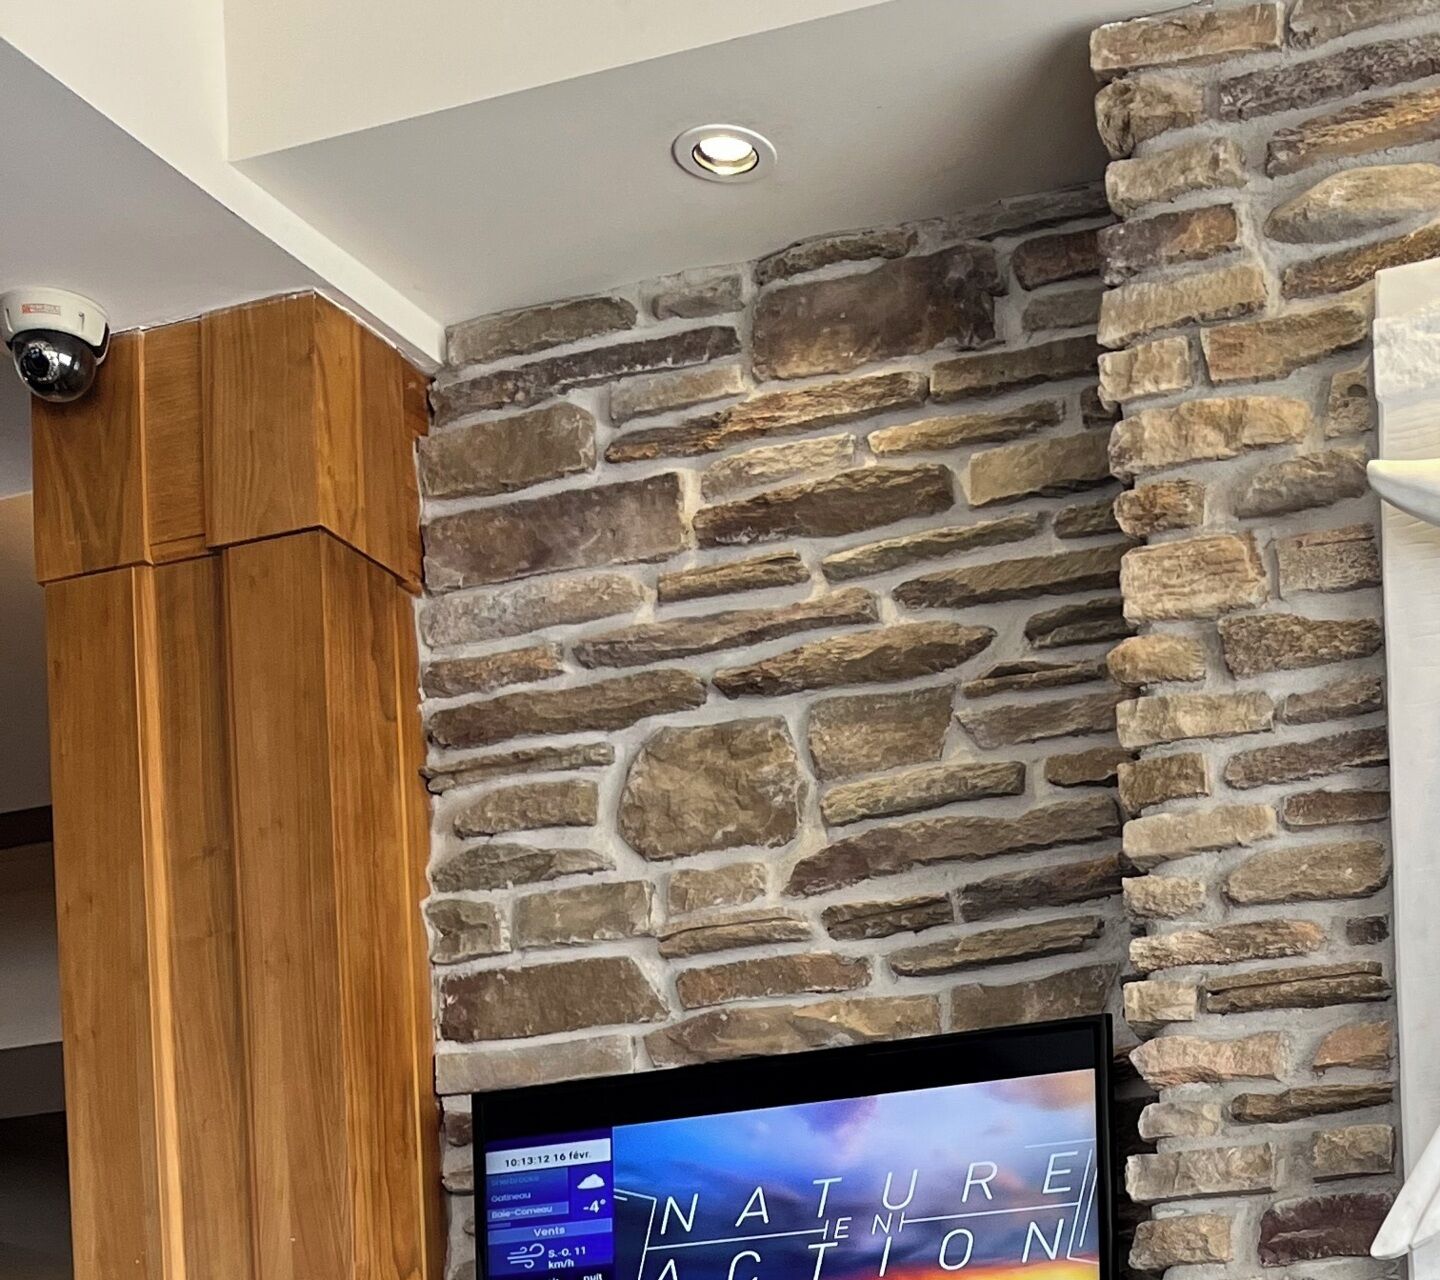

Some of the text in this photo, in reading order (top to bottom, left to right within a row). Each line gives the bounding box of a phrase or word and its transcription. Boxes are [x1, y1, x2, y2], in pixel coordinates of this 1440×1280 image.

[505, 1155, 549, 1167] 10:13:12
[554, 1153, 566, 1162] 16
[660, 1150, 1079, 1235] NATURE
[534, 1226, 565, 1237] Vents
[833, 1212, 893, 1239] EN
[575, 1246, 586, 1255] 11
[548, 1259, 575, 1269] km/h
